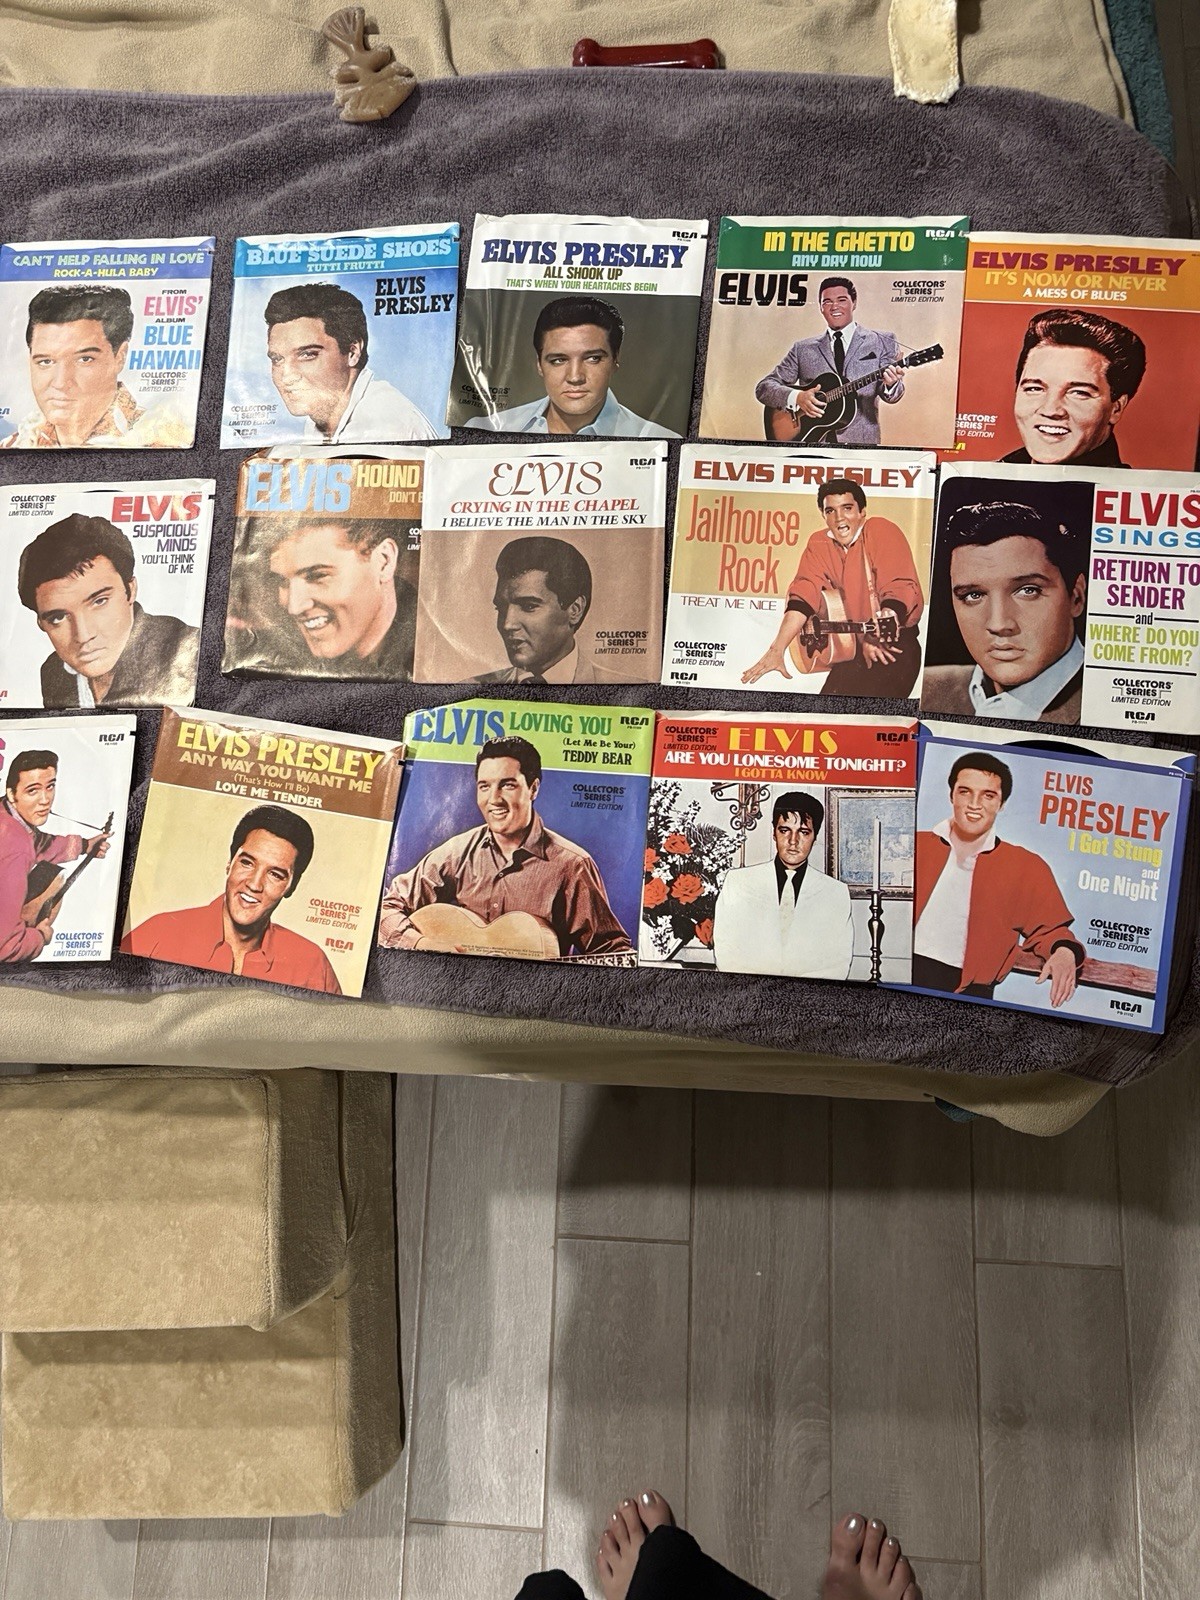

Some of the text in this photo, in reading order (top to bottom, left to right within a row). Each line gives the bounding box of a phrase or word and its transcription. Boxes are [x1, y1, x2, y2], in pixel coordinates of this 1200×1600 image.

[763, 232, 915, 252] IN THE GHETTO
[926, 230, 955, 238] RCA
[13, 252, 204, 266] CAN'T HELP FALLING IN LOVE
[247, 239, 451, 265] BLUE SUEDE SHOES
[481, 240, 689, 268] ELVIS PRESLEY
[307, 261, 385, 272] TUTTI FRUTTI
[792, 255, 882, 267] ANY DAY NOW
[973, 252, 1186, 275] ELVIS PRESLEY
[54, 268, 158, 277] ROCK-A-HULA BABY
[544, 267, 623, 280] ALL SHOOK UP
[375, 276, 426, 296] ELVIS
[506, 279, 658, 291] THAT'S WHEN YOUR HEARTACHES BEGIN
[893, 280, 947, 288] COLLECTORS'
[985, 271, 1167, 291] IT'S NOW OR NEVER
[718, 273, 808, 307] ELVIS
[1023, 288, 1127, 301] A MESS OF BLUES
[144, 297, 203, 316] ELVIS'
[374, 294, 454, 316] PRESLEY
[144, 326, 193, 345] BLUE
[129, 350, 201, 370] HAWAII
[630, 458, 656, 466] RCA
[356, 465, 420, 488] HOUND
[489, 462, 602, 496] ELVIS
[694, 461, 921, 488] ELVIS PRESLEY
[246, 464, 352, 512] ELVIS
[389, 491, 415, 503] DON'T
[111, 495, 203, 522] ELVIS
[451, 499, 640, 513] CRYING IN THE CHAPEL
[1095, 491, 1200, 528] ELVIS
[442, 514, 647, 527] I BELIEVE THE MAN IN THE SKY
[686, 494, 800, 546] Jailhouse
[133, 524, 198, 538] SUSPICIOUS
[1094, 527, 1200, 548] SINGS
[157, 539, 197, 552] MINDS
[141, 554, 194, 564] YOU'LL THINK
[168, 564, 193, 573] OF ME
[718, 544, 780, 594] Rock
[1093, 558, 1200, 586] RETURN TO
[681, 596, 777, 611] TREAT ME NICE
[1107, 584, 1185, 610] SENDER
[1135, 613, 1153, 625] and
[1089, 624, 1199, 647] WHERE DO YOU
[674, 641, 727, 650] COLLECTORS'
[686, 649, 713, 658] SERIES
[672, 658, 725, 667] LIMITED EDITION
[1094, 644, 1192, 667] COME FROM?
[670, 672, 698, 681] RCA
[1113, 678, 1173, 689] COLLECTORS'
[1126, 687, 1157, 697] SERIES
[1111, 696, 1171, 706] LIMITED EDITION
[509, 712, 612, 736] LOVING YOU
[1125, 711, 1155, 721] RCA
[412, 708, 505, 746] ELVIS
[99, 734, 124, 742] RCA
[563, 737, 636, 749] (Let Me Be Your)
[729, 728, 838, 754] ELVIS
[877, 733, 908, 742] RCA
[177, 722, 384, 780] ELVIS PRESLEY
[563, 750, 632, 765] TEDDY BEAR
[664, 752, 906, 772] ARE YOU LONESOME TONIGHT?
[179, 751, 372, 793] ANY WAY YOU WANT ME
[735, 768, 828, 781] I GOTTA KNOW
[234, 772, 261, 784] (That's
[264, 778, 283, 788] How
[296, 783, 310, 794] Be)
[1044, 771, 1093, 797] ELVIS
[215, 781, 323, 808] LOVE ME TENDER
[1040, 795, 1170, 842] PRESLEY
[1079, 834, 1163, 867] Got Stung
[1141, 869, 1160, 880] and
[1078, 870, 1158, 902] One Night
[1090, 919, 1152, 936] COLLECTORS'
[65, 940, 90, 948] SERIES
[1103, 930, 1135, 942] SERIES
[325, 938, 354, 951] RCA
[1087, 938, 1148, 954] LIMITED EDITION
[1110, 1000, 1142, 1014] RCA
